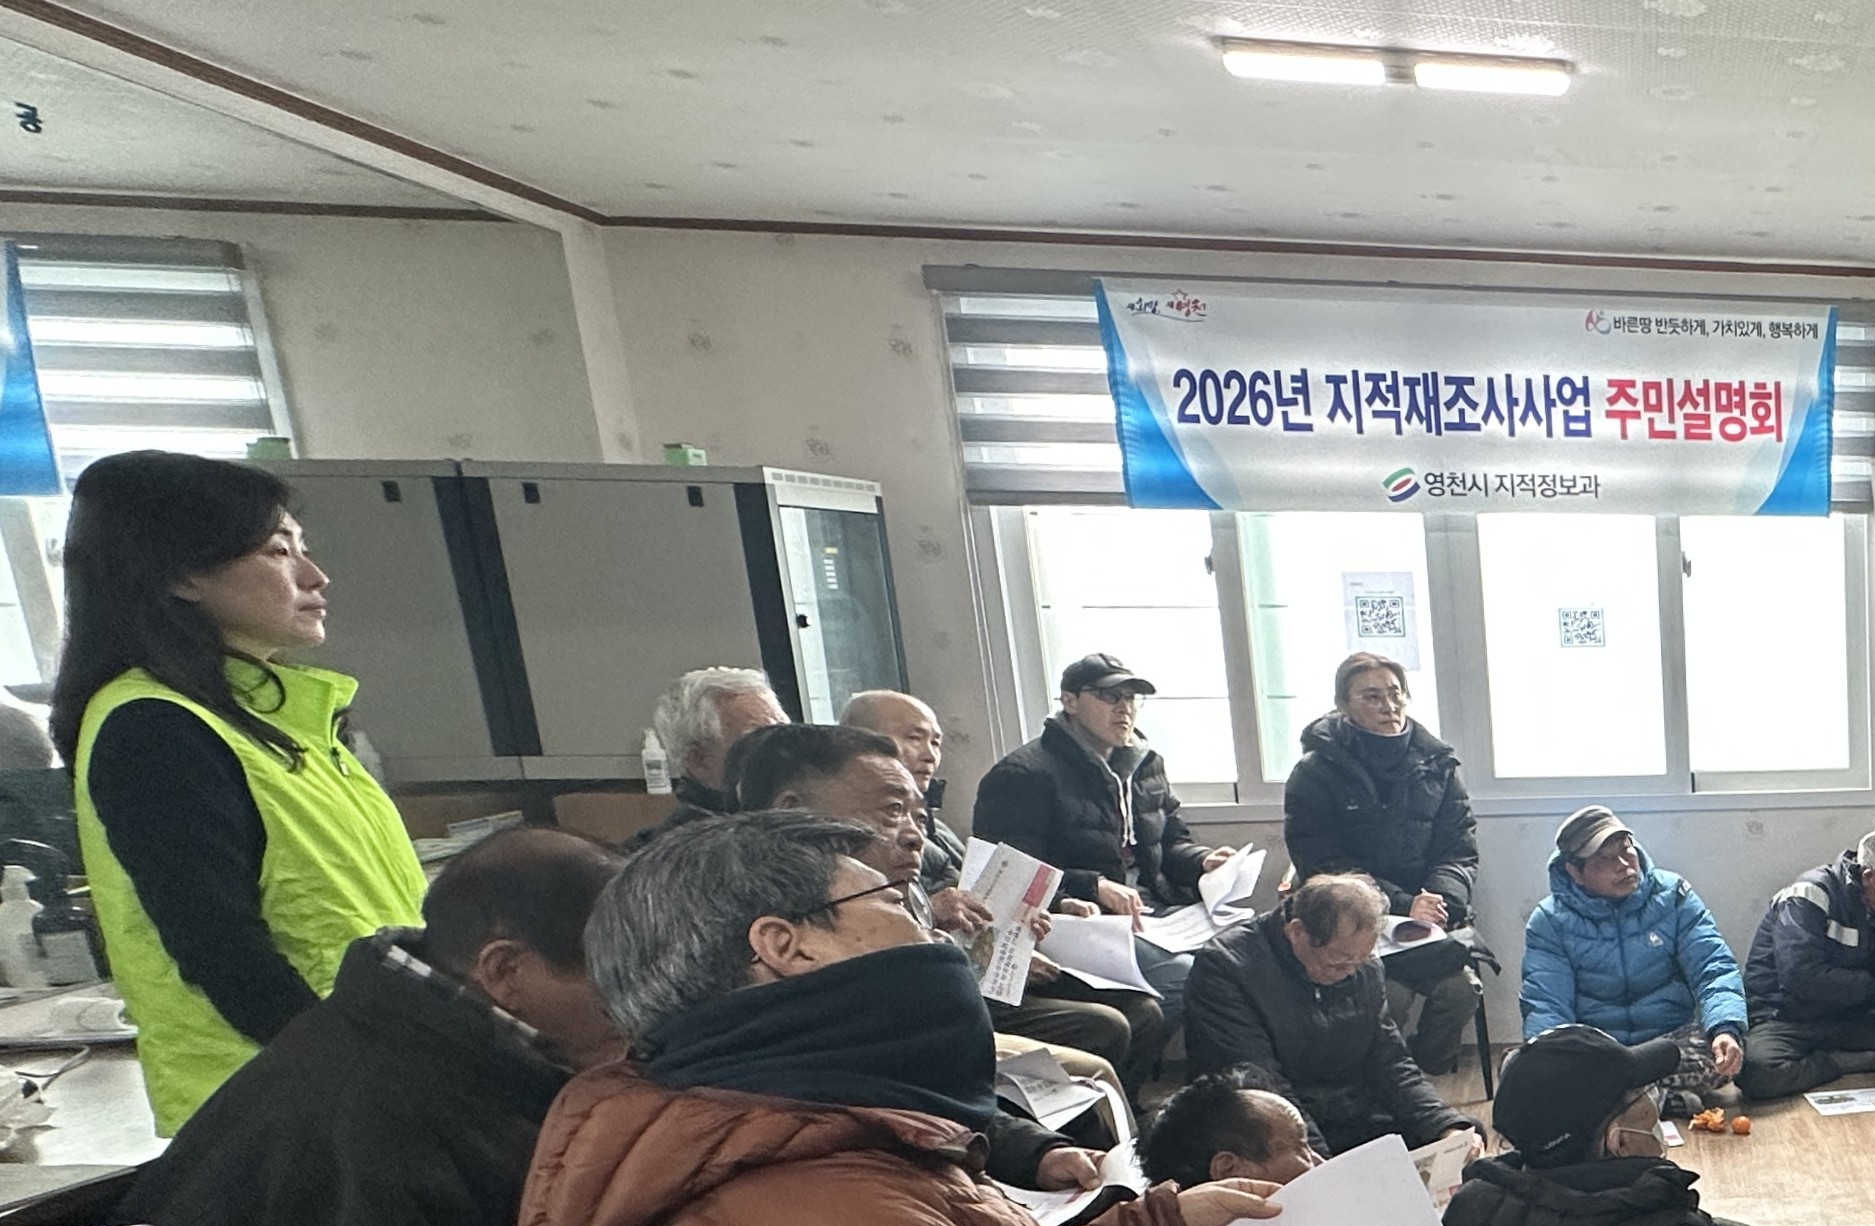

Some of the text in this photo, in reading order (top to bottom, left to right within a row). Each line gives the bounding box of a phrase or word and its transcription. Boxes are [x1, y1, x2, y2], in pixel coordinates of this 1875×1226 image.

[1613, 316, 1820, 340] 바른땅 반듯하게, 가치있게, 행복하게
[1172, 367, 1784, 443] 2026년 지적재조사사업 주민설명회
[1423, 471, 1602, 499] 영천시 지적정보과
